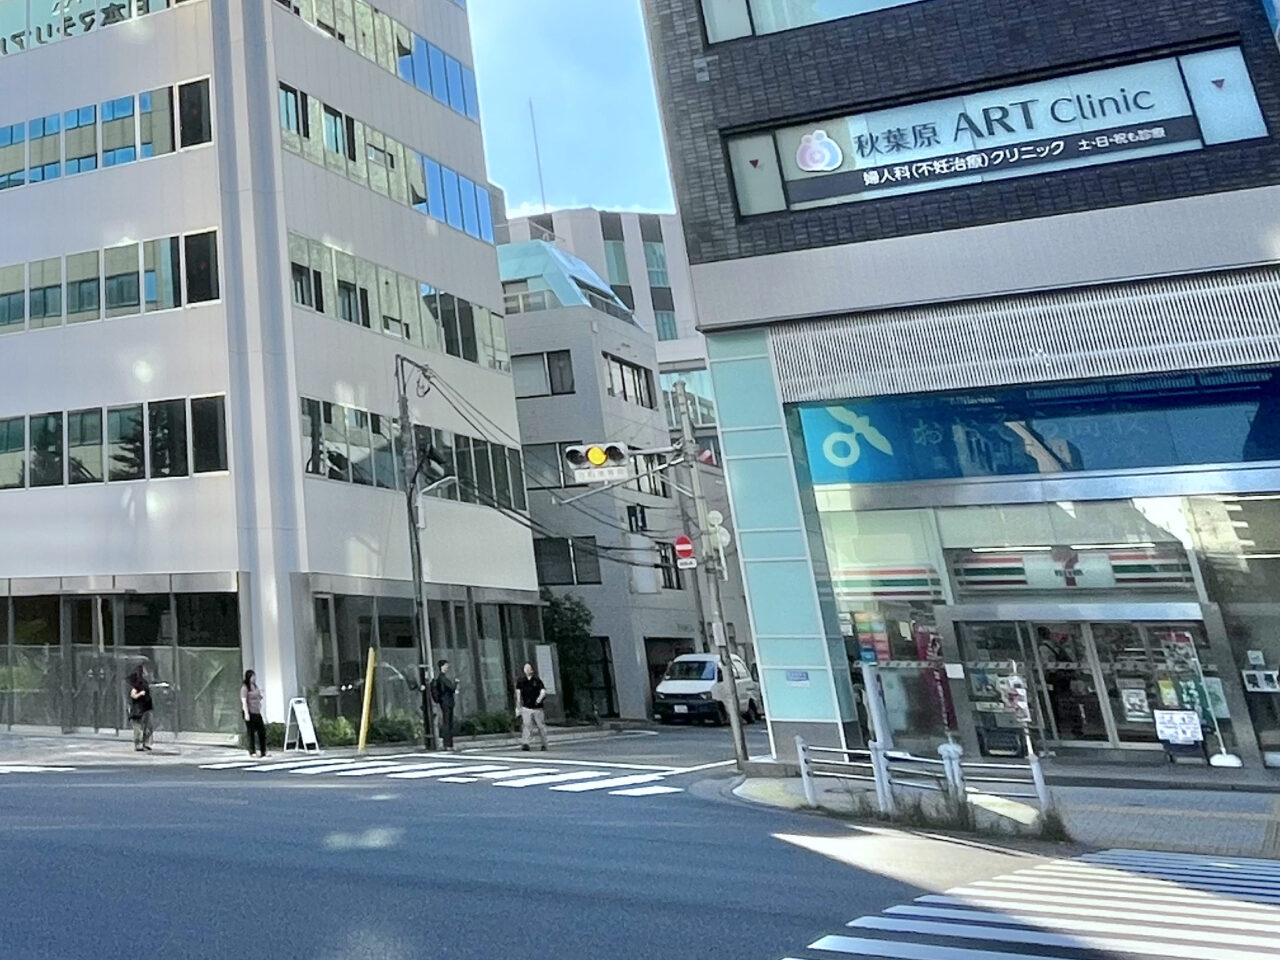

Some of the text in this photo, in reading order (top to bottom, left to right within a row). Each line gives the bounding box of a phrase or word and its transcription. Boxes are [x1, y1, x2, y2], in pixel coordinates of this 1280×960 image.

[854, 87, 1155, 158] 秋葉原 ART Clinic
